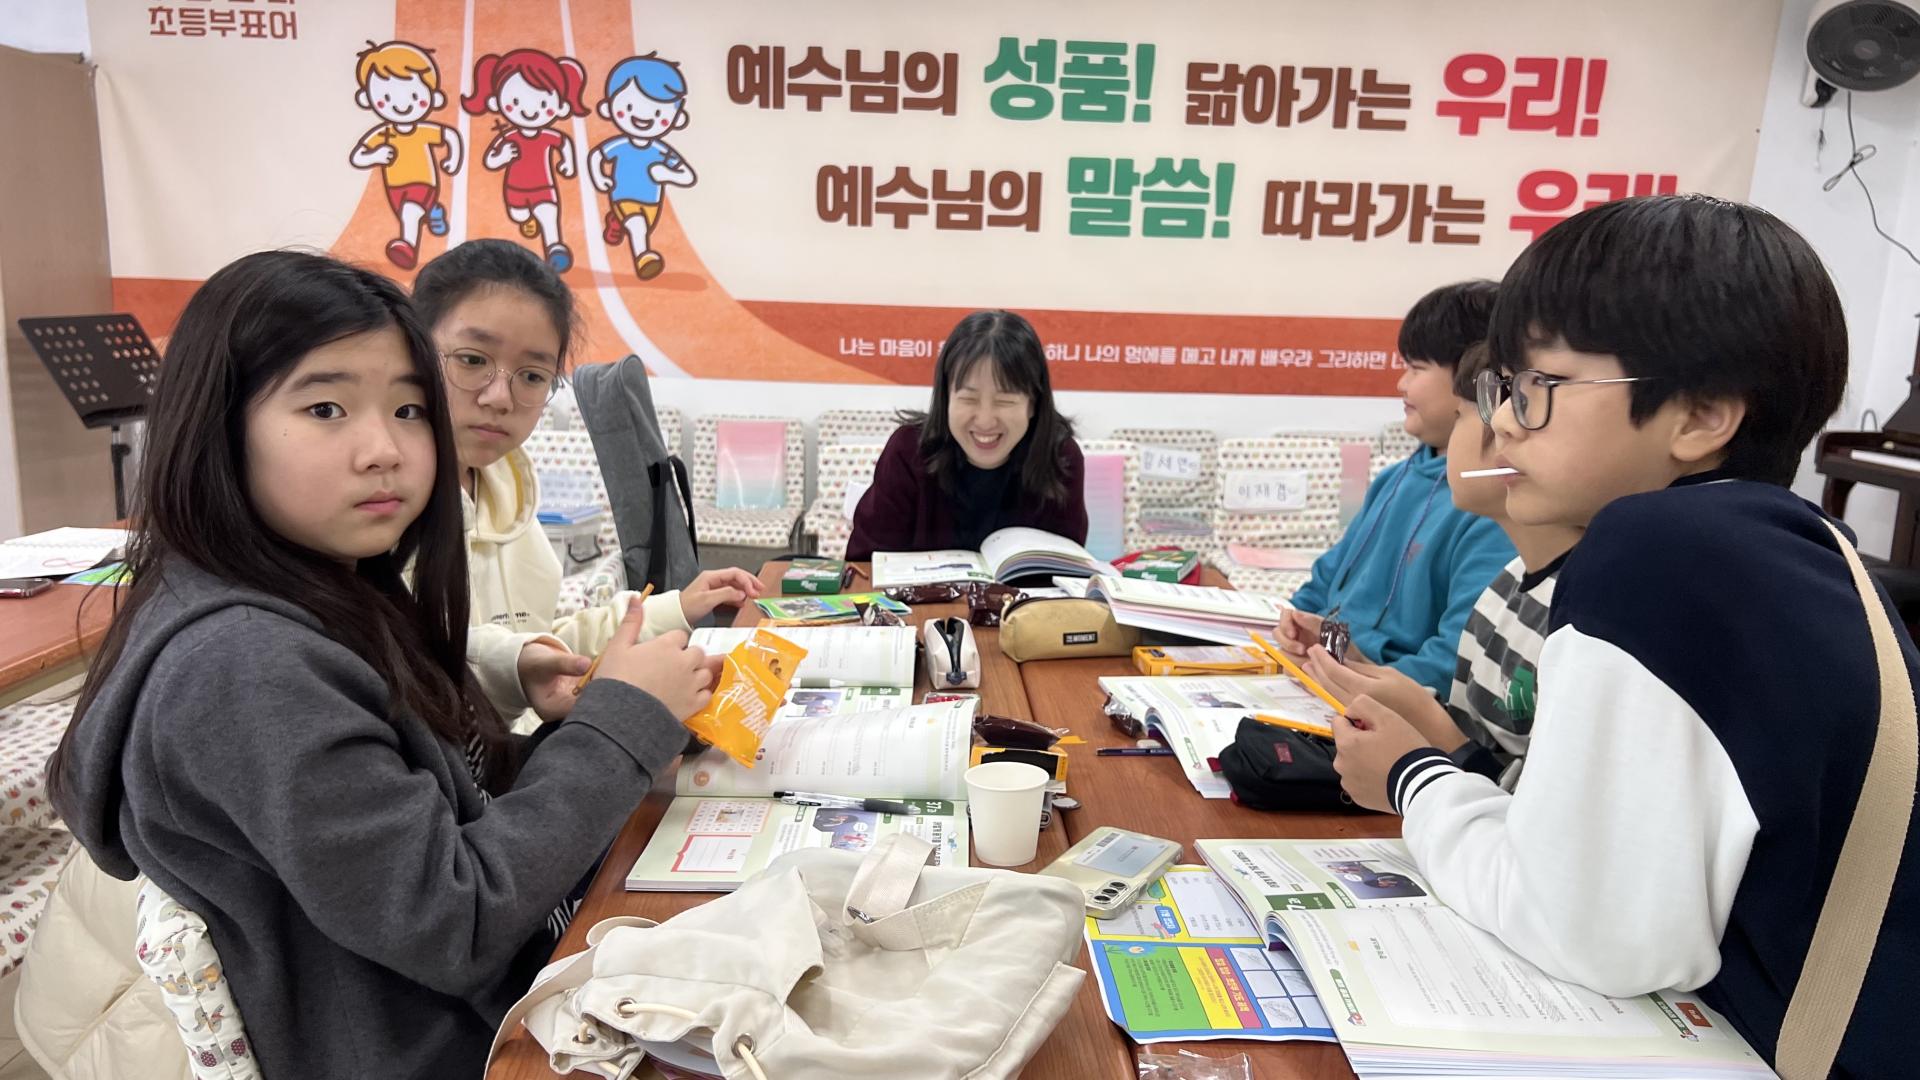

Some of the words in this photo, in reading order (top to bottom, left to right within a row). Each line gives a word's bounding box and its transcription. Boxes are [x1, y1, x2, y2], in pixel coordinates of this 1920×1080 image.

[148, 6, 297, 40] 초등부표어
[726, 44, 959, 116] 예수님의
[983, 37, 1156, 123] 성품!
[1185, 62, 1411, 131] 닮아가는
[1436, 52, 1607, 137] 우리!
[815, 164, 1043, 233] 예수님의
[1067, 156, 1236, 238] 말씀!
[1262, 180, 1486, 245] 따라가는
[839, 337, 875, 357] 나는
[880, 339, 932, 358] 마음이
[1084, 344, 1120, 363] 나의
[1124, 344, 1177, 366] 멍에를
[1181, 346, 1216, 366] 메고
[1220, 347, 1256, 367] 내게
[1260, 347, 1312, 368] 배우라
[1317, 350, 1386, 370] 그리하면
